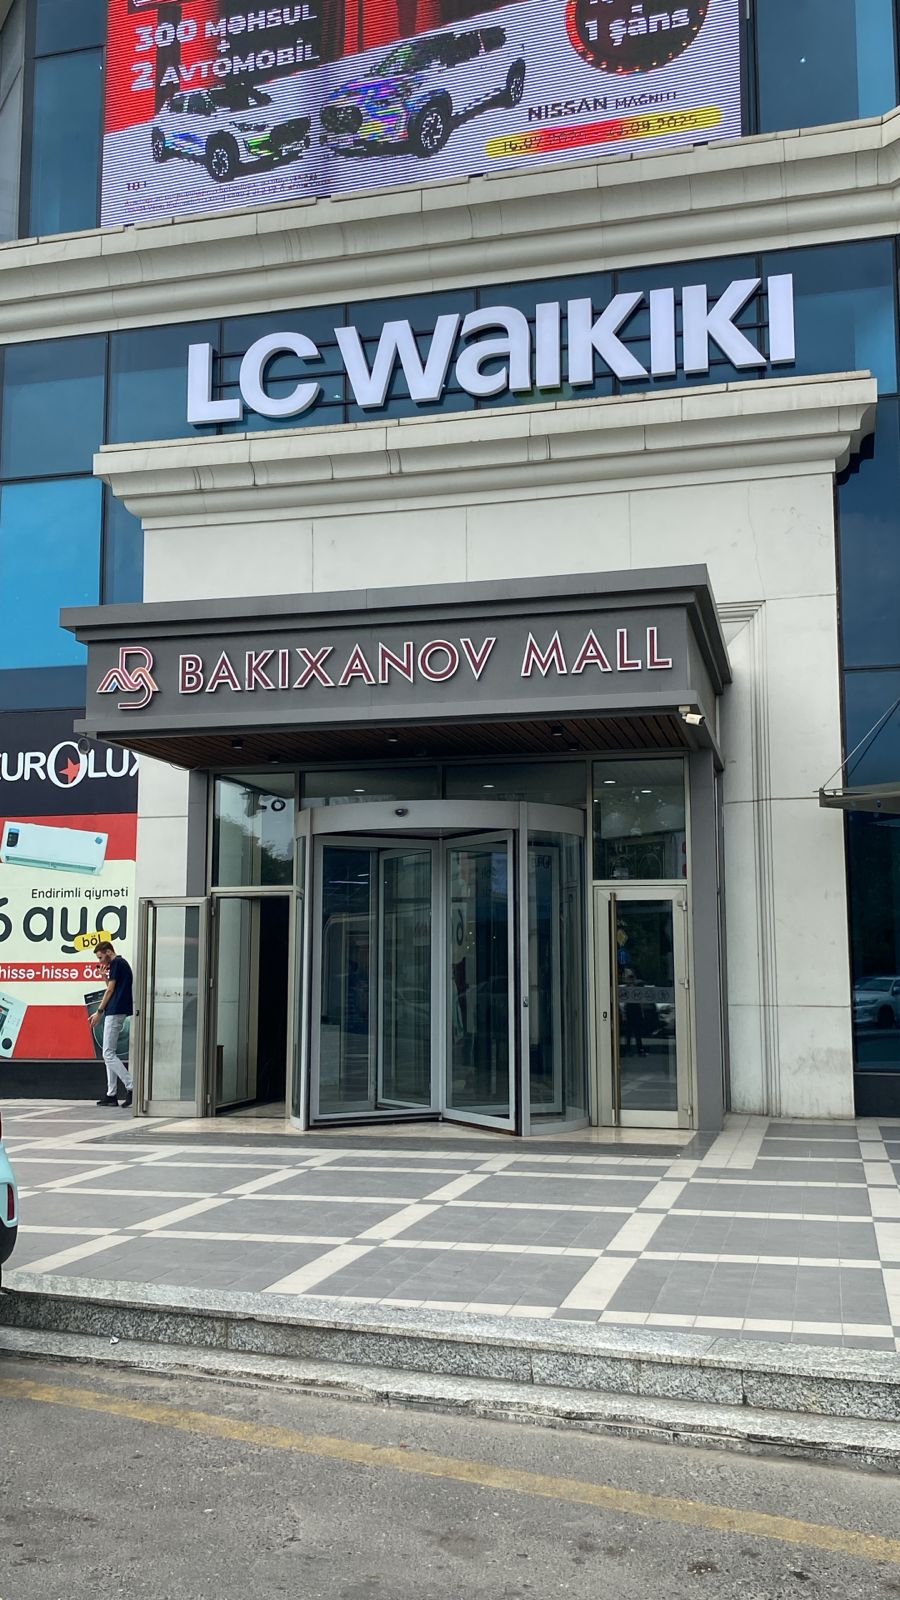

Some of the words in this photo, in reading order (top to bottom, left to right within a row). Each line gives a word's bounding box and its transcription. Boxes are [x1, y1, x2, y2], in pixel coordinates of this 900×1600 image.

[134, 18, 198, 52] 300
[204, 4, 318, 38] MƏHSUL
[584, 19, 598, 41] 1
[130, 61, 156, 91] 2
[159, 37, 320, 87] AVTOMOBİL
[527, 97, 608, 122] NISSAN
[187, 331, 323, 425] LC
[178, 636, 496, 695] BAKIXANOV
[521, 625, 673, 678] MALL
[31, 888, 81, 899] Endirimli
[84, 887, 129, 900] qiyməti
[23, 905, 127, 954] aya
